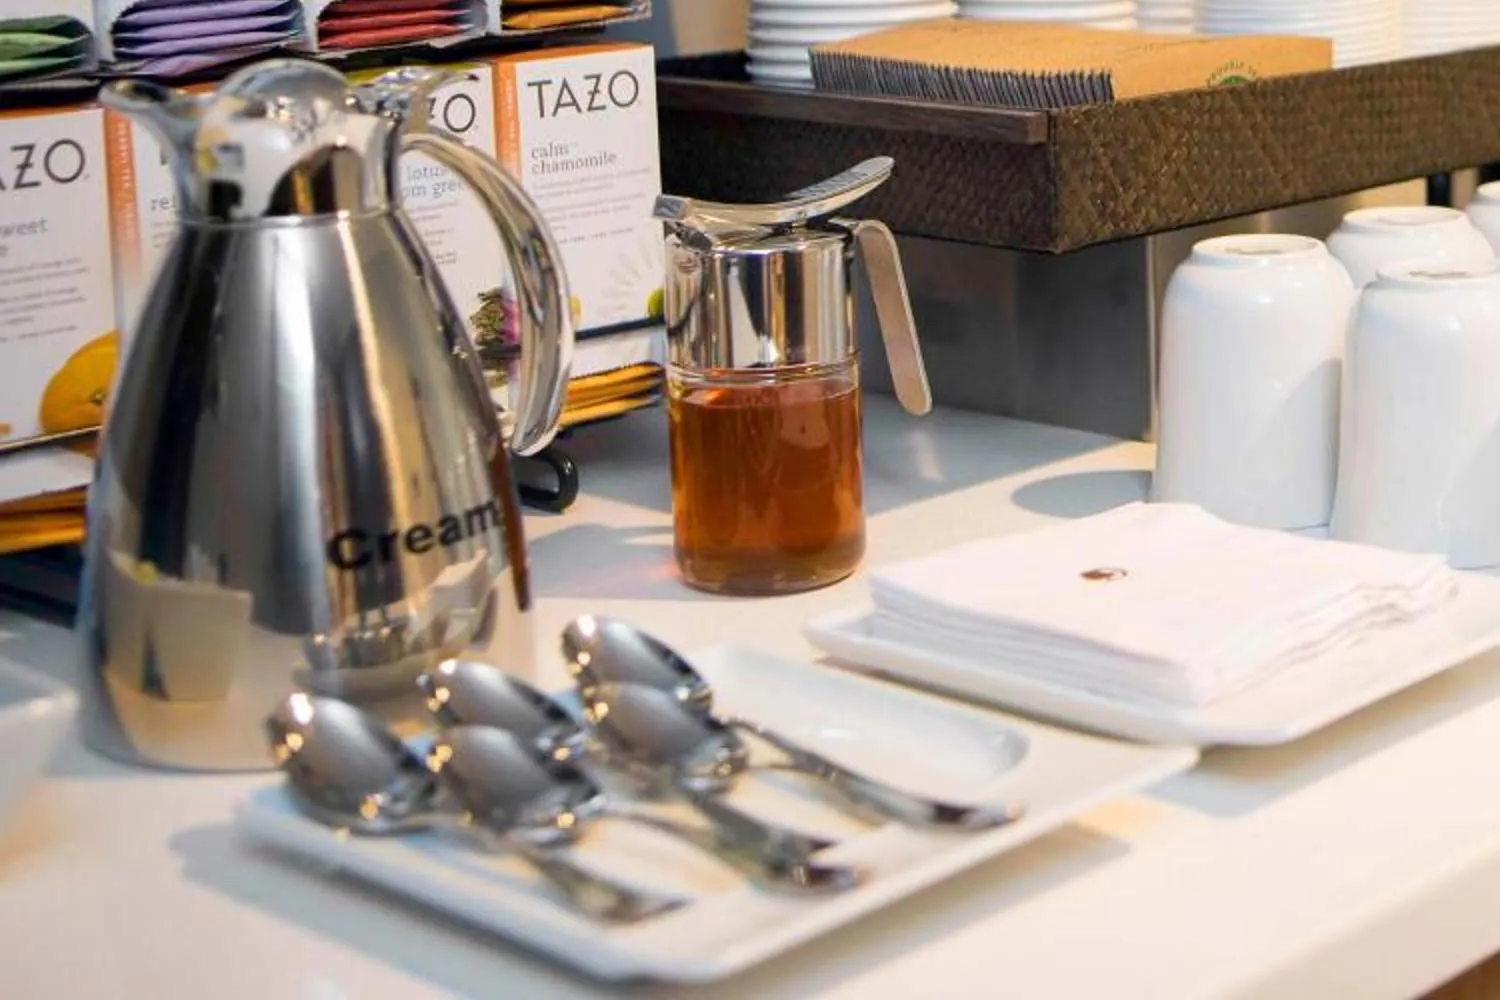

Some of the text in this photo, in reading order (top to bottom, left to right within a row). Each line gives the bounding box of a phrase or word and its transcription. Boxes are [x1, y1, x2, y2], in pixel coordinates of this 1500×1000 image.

[531, 141, 569, 161] calm
[531, 151, 618, 175] chamomile
[0, 217, 49, 238] weet
[326, 499, 500, 570] Cream
